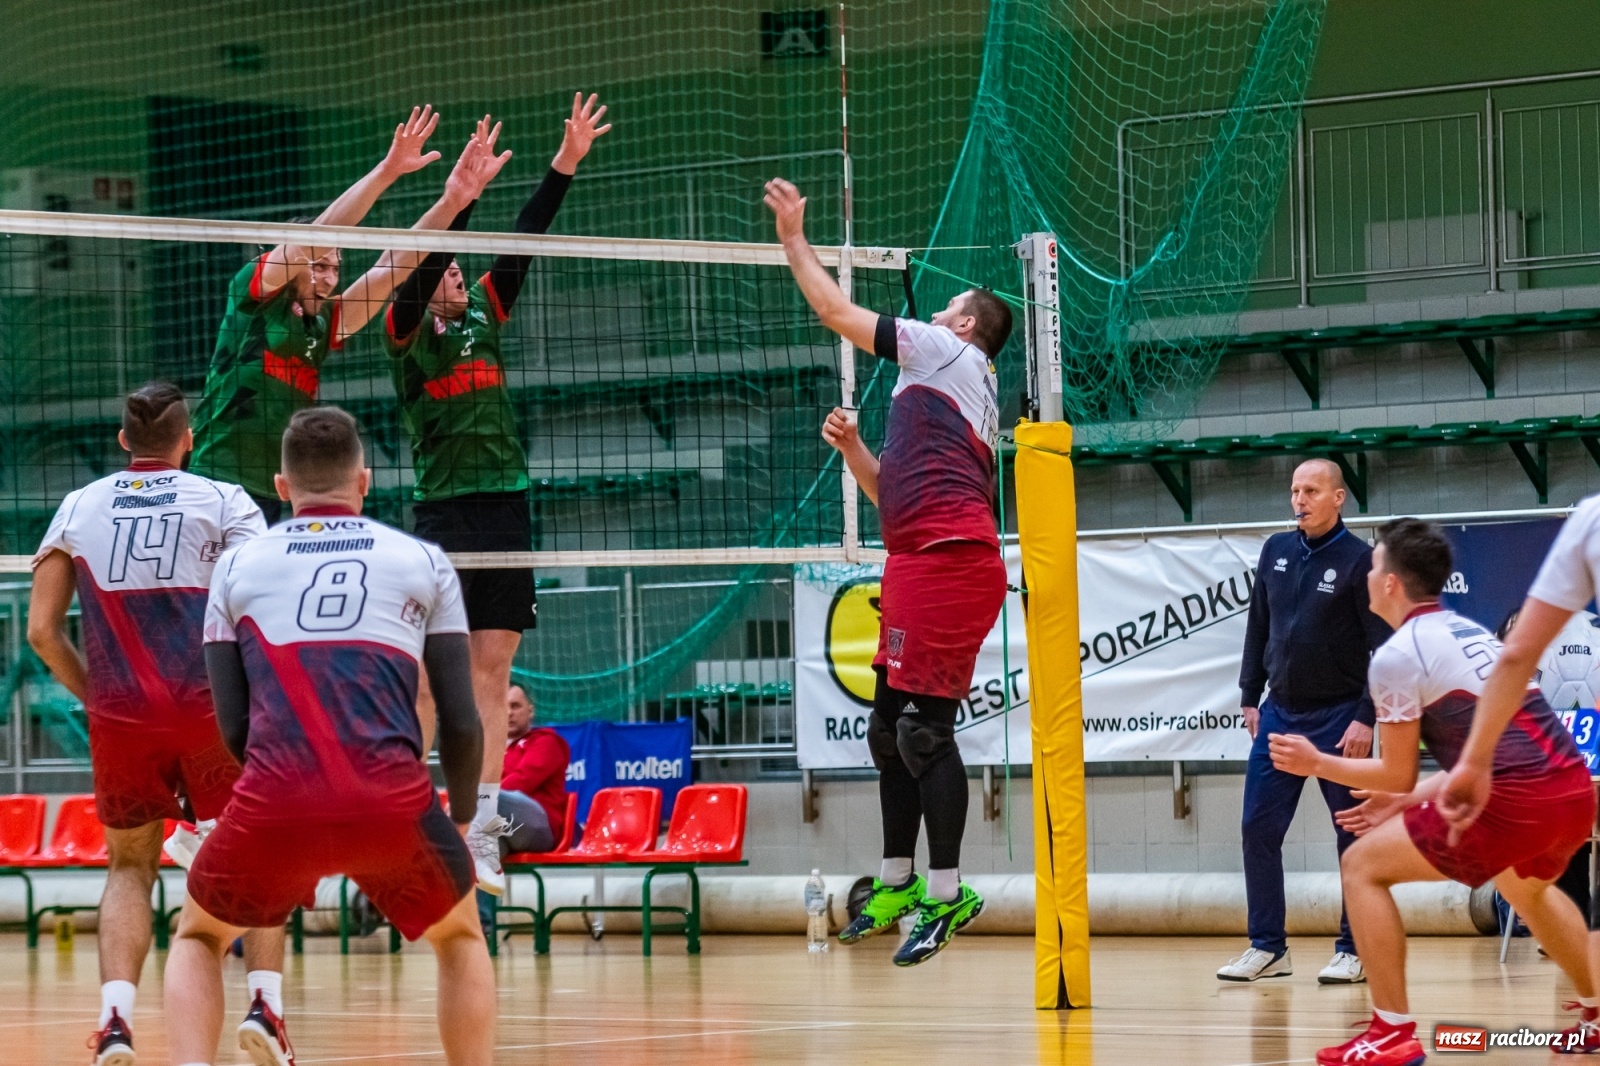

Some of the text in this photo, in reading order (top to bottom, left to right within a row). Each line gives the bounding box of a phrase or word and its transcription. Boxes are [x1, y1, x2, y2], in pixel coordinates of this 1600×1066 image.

[108, 512, 184, 583] 14
[296, 559, 368, 633] 8
[615, 756, 683, 781] molten
